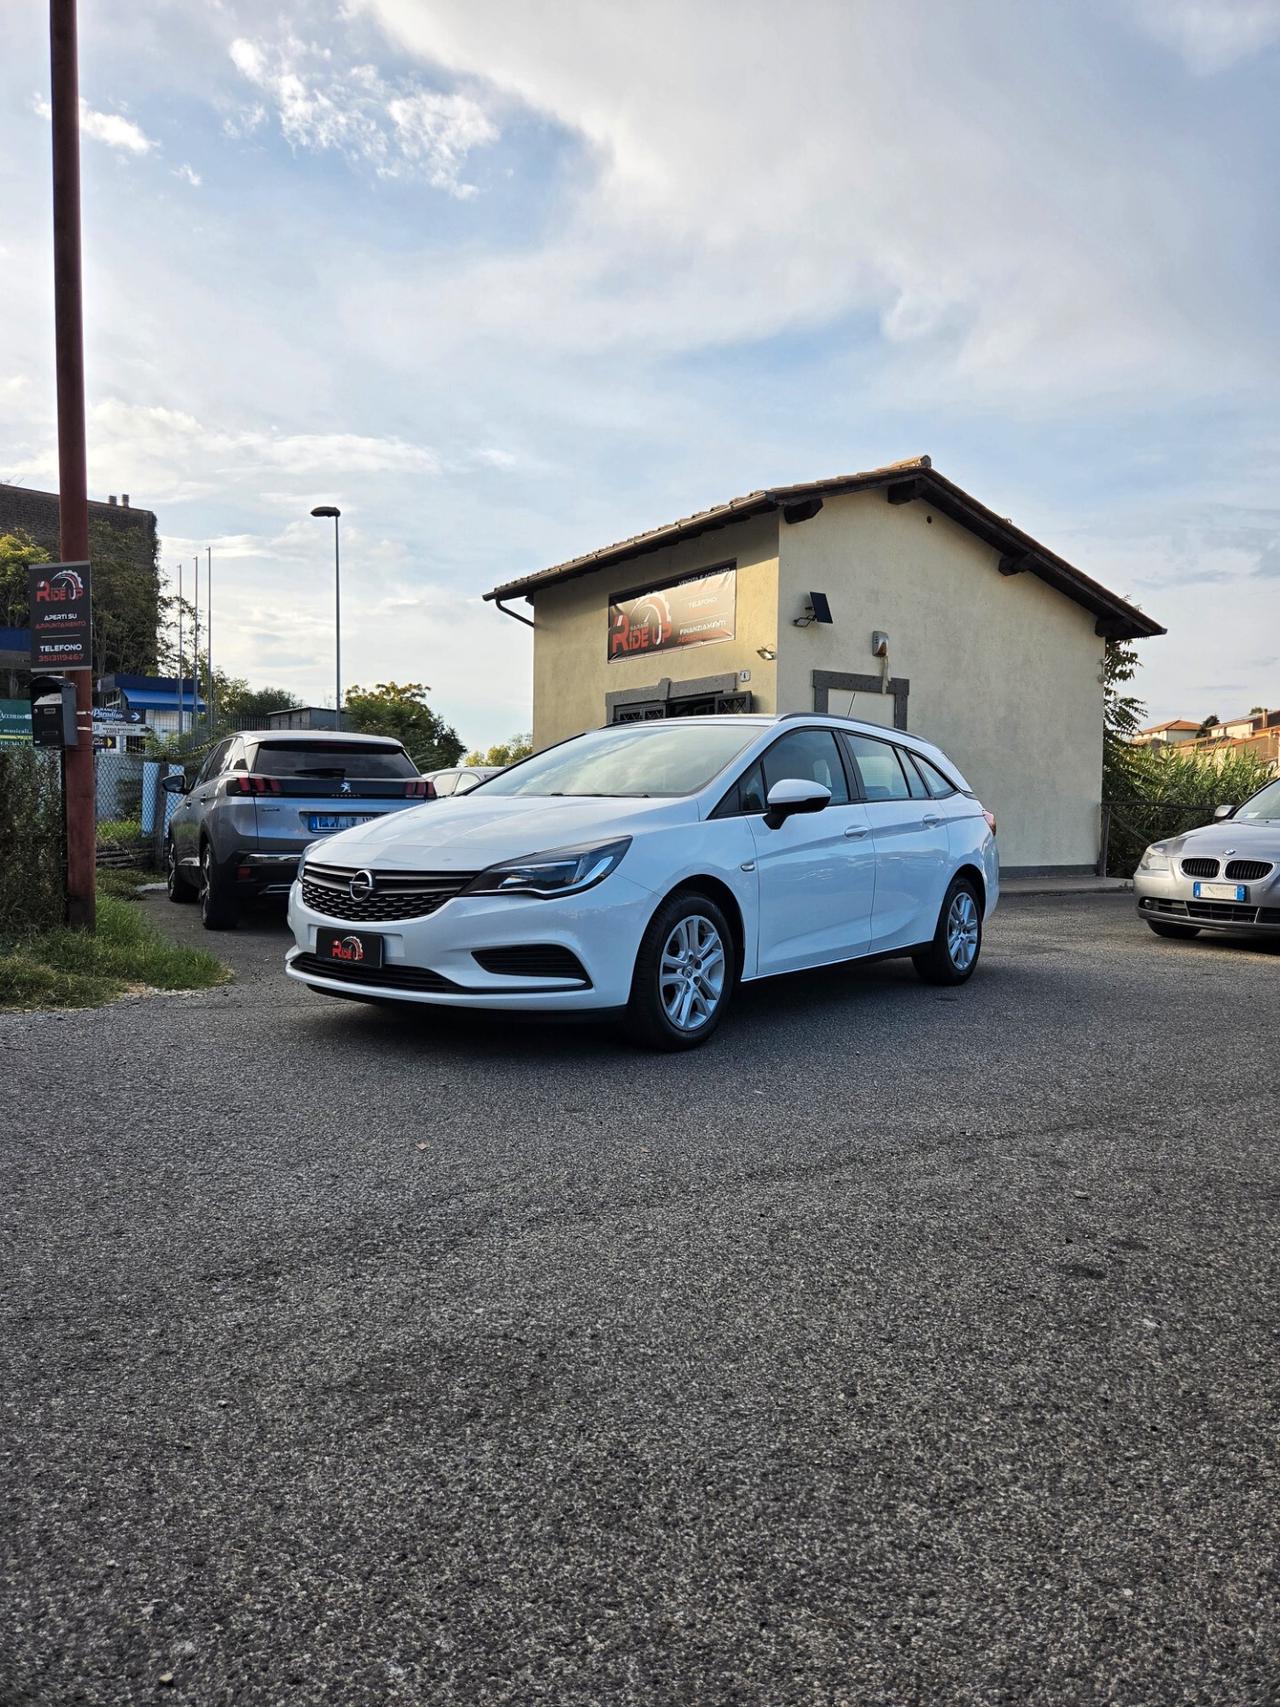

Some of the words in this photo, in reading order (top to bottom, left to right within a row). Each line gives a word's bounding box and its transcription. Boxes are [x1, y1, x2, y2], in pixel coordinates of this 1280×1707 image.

[36, 580, 66, 602] RIDE
[612, 614, 649, 655] RIDE
[40, 643, 82, 652] TELEFONO
